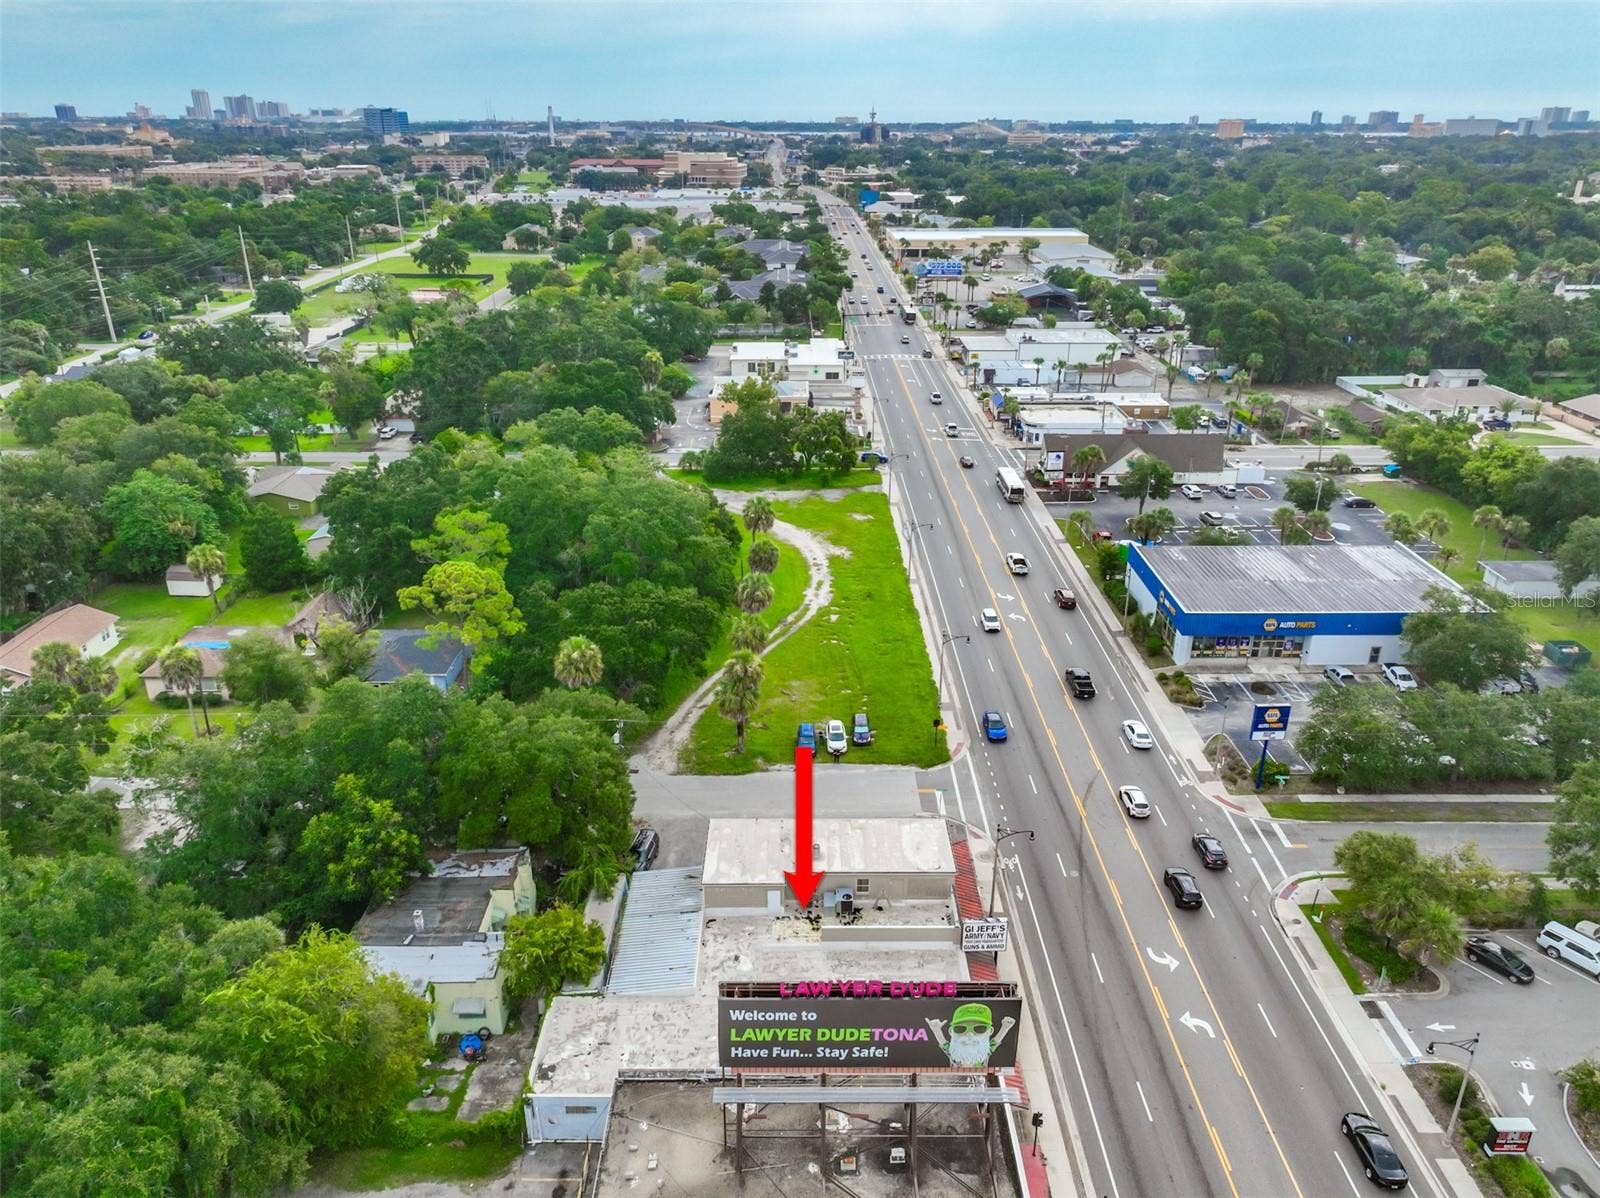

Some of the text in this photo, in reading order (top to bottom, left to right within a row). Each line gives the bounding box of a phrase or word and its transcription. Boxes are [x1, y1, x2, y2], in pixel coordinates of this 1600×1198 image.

[779, 980, 958, 998] LAWYER DUDE
[729, 1010, 818, 1021] Welcome to
[730, 1028, 929, 1042] LAWYER DUDETONA
[730, 1046, 888, 1060] Have Fun... Stay Safe!
